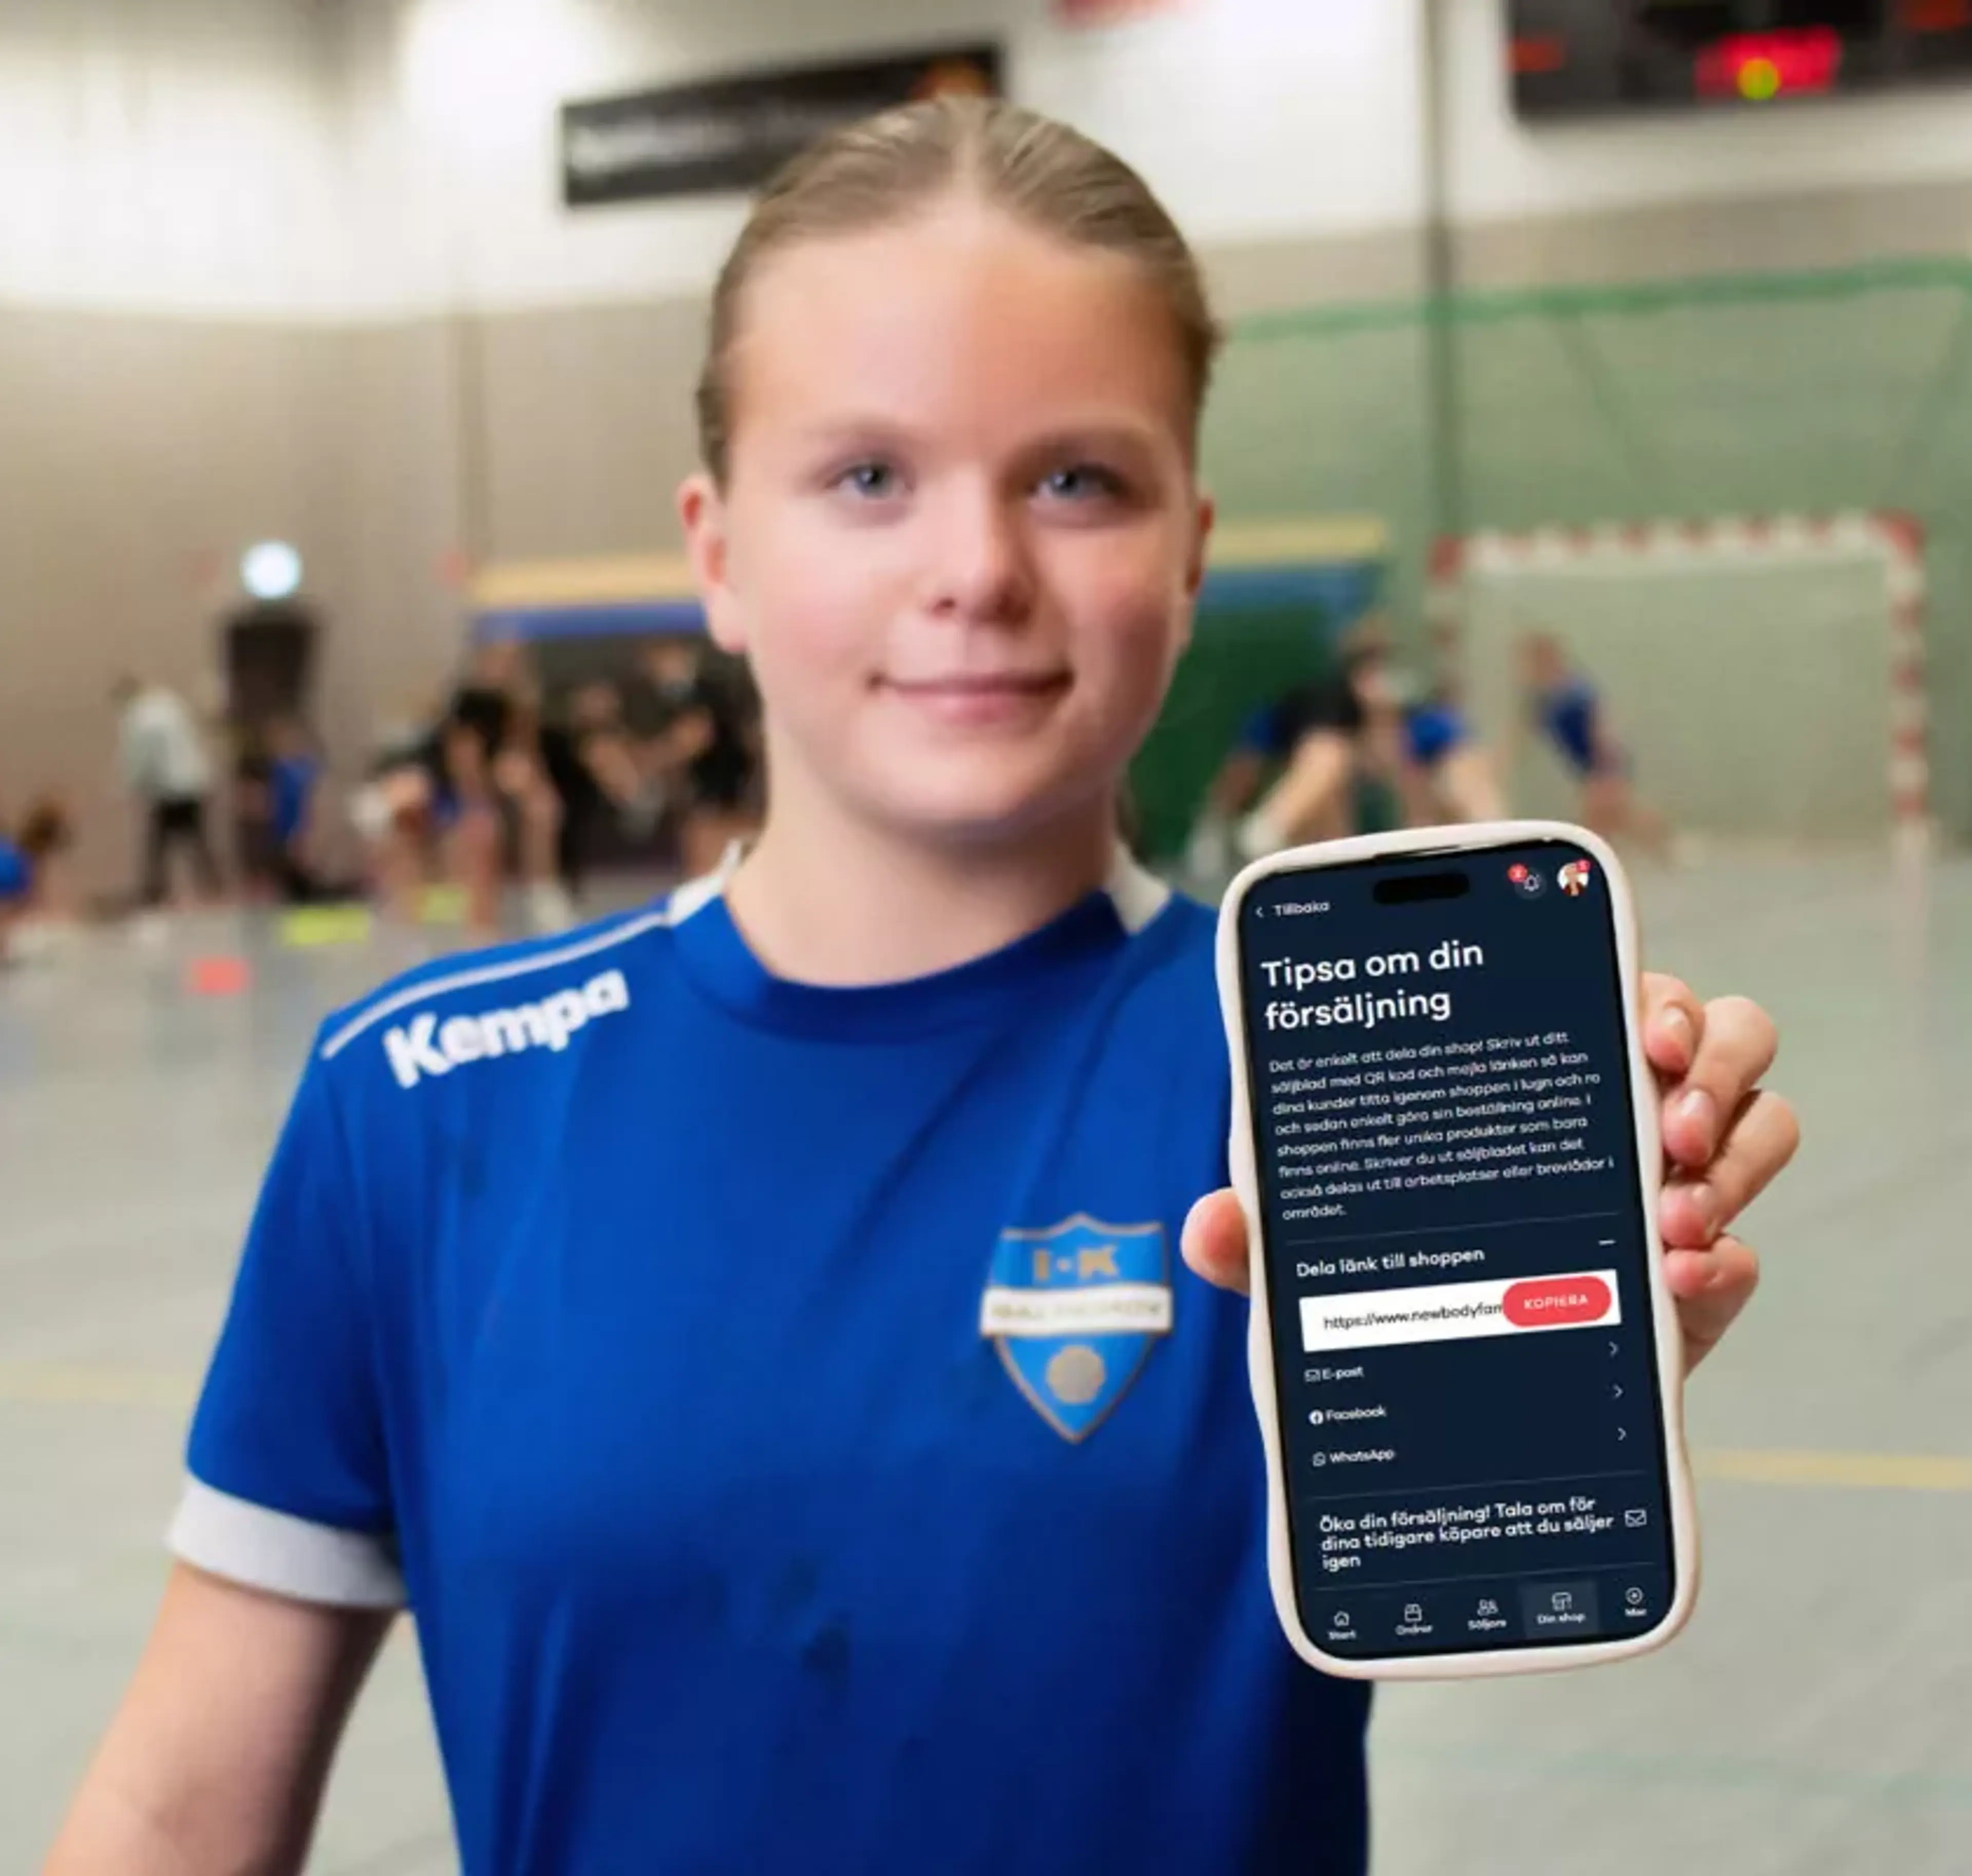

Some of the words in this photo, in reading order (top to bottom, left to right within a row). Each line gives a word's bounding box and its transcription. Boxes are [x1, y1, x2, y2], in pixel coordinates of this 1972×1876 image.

[1274, 901, 1330, 916] Tillbaka
[1261, 956, 1355, 991] Tipsa
[1365, 948, 1420, 977] om
[1429, 940, 1484, 971] din
[1265, 991, 1452, 1030] försäljning
[383, 968, 630, 1089] Kempa
[1268, 1060, 1295, 1072] Det
[1297, 1058, 1314, 1069] är
[1316, 1052, 1358, 1068] enkelt
[1360, 1051, 1383, 1064] att
[1386, 1048, 1416, 1060] dela
[1418, 1044, 1442, 1057] din
[1445, 1041, 1483, 1055] shop!
[1487, 1038, 1522, 1051] Skriv
[1525, 1034, 1540, 1047] ut
[1543, 1032, 1569, 1045] ditt
[1271, 1078, 1326, 1094] säljblad
[1330, 1074, 1361, 1087] med
[1364, 1072, 1385, 1086] QR
[1388, 1069, 1415, 1082] kod
[1418, 1066, 1445, 1079] och
[1447, 1063, 1487, 1076] mejla
[1489, 1057, 1538, 1072] länken
[1541, 1054, 1558, 1067] så
[1560, 1052, 1588, 1064] kan
[1273, 1102, 1304, 1115] dina
[1307, 1097, 1356, 1111] kunder
[1360, 1093, 1390, 1106] titta
[1393, 1088, 1446, 1105] igenom
[1449, 1081, 1510, 1097] shoppen
[1521, 1077, 1552, 1091] lugn
[1555, 1073, 1582, 1087] och
[1585, 1073, 1601, 1084] ro
[1275, 1123, 1302, 1135] och
[1304, 1118, 1347, 1133] sedan
[1351, 1112, 1394, 1127] enkelt
[1396, 1110, 1429, 1126] göra
[1433, 1108, 1453, 1120] sin
[1456, 1100, 1534, 1116] beställning
[1277, 1142, 1337, 1157] shoppen
[1340, 1138, 1375, 1150] finns
[1377, 1133, 1400, 1146] fler
[1405, 1130, 1443, 1145] unika
[1447, 1123, 1516, 1142] produkter
[1520, 1121, 1550, 1134] som
[1552, 1116, 1588, 1130] bara
[1278, 1165, 1314, 1179] finns
[1364, 1154, 1413, 1169] Skriver
[1416, 1151, 1435, 1165] du
[1438, 1150, 1454, 1162] ut
[1456, 1143, 1527, 1162] säljbladet
[1529, 1141, 1556, 1153] kan
[1560, 1138, 1583, 1150] det
[1280, 1185, 1323, 1200] också
[1325, 1181, 1363, 1196] delas
[1367, 1180, 1381, 1192] ut
[1384, 1176, 1401, 1190] till
[1404, 1168, 1500, 1188] arbetsplatser
[1503, 1165, 1533, 1179] eller
[1297, 1262, 1336, 1277] Dela
[1339, 1257, 1377, 1274] länk
[1381, 1253, 1406, 1269] till
[1409, 1249, 1485, 1268] shoppen
[1524, 1294, 1589, 1310] KOPIERA
[1322, 1366, 1364, 1380] E-post
[1326, 1405, 1387, 1420] Facebook
[1330, 1449, 1395, 1463] WhatsApp
[1319, 1514, 1356, 1532] Öka
[1359, 1515, 1387, 1529] din
[1391, 1507, 1491, 1529] försäljning!
[1494, 1502, 1533, 1518] Tala
[1538, 1500, 1566, 1515] om
[1569, 1497, 1596, 1512] för
[1321, 1534, 1361, 1552] dina
[1364, 1531, 1435, 1549] tidigare
[1439, 1524, 1501, 1543] köpare
[1506, 1521, 1533, 1536] att
[1537, 1517, 1561, 1534] du
[1564, 1514, 1614, 1533] säljer
[1322, 1554, 1361, 1572] igen
